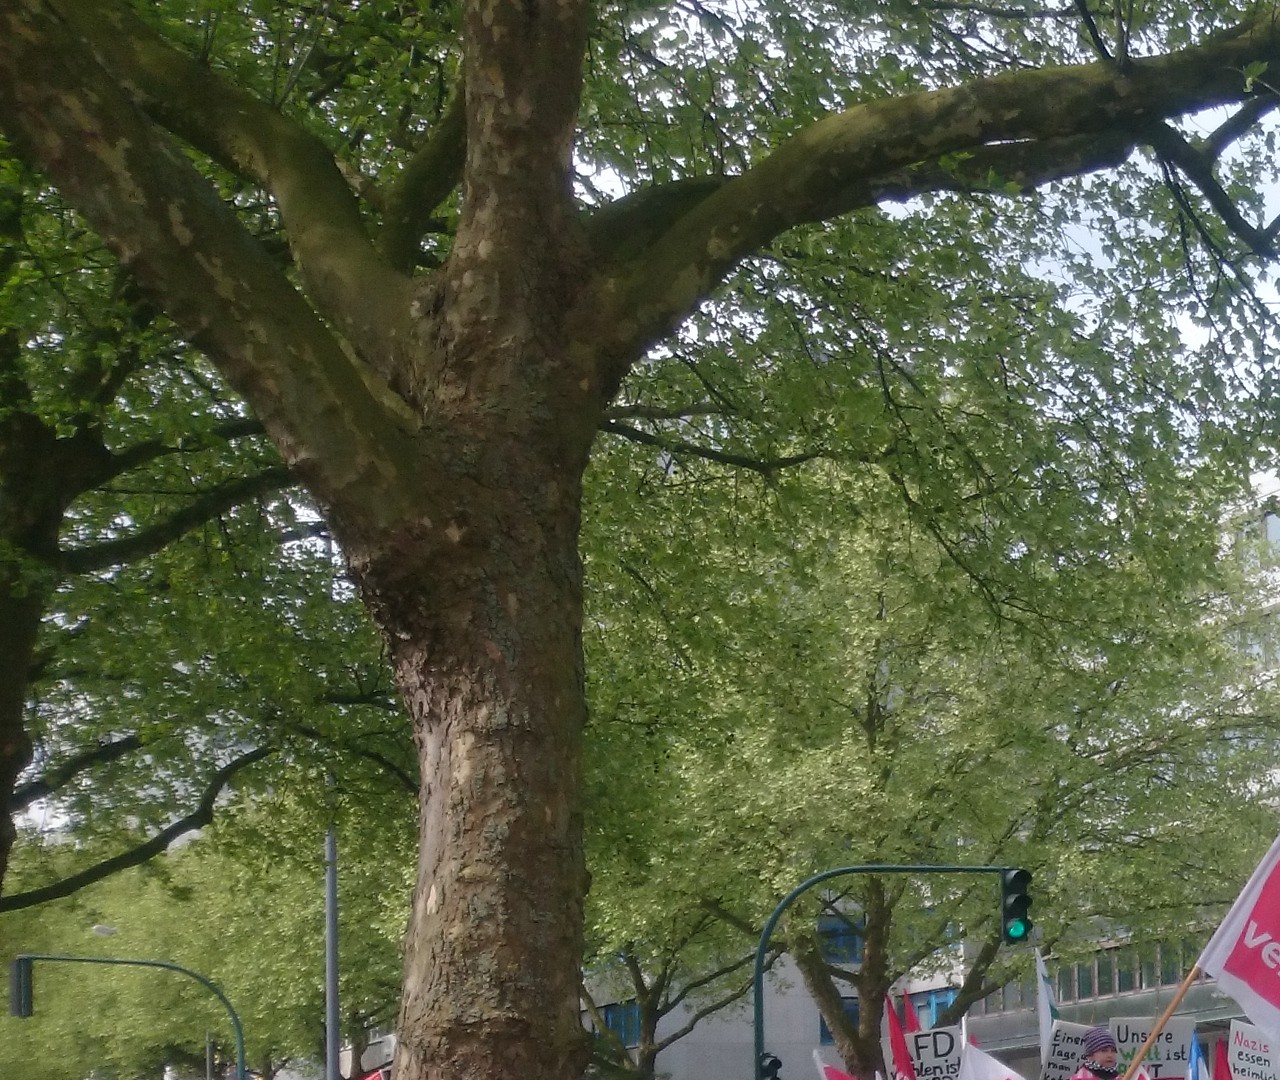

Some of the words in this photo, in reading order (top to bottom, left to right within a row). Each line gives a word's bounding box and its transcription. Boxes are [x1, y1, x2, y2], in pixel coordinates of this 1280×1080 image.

[909, 1031, 956, 1061] FD
[1233, 1030, 1270, 1053] Nazis
[1165, 1044, 1188, 1061] ist
[1237, 1050, 1271, 1067] essen
